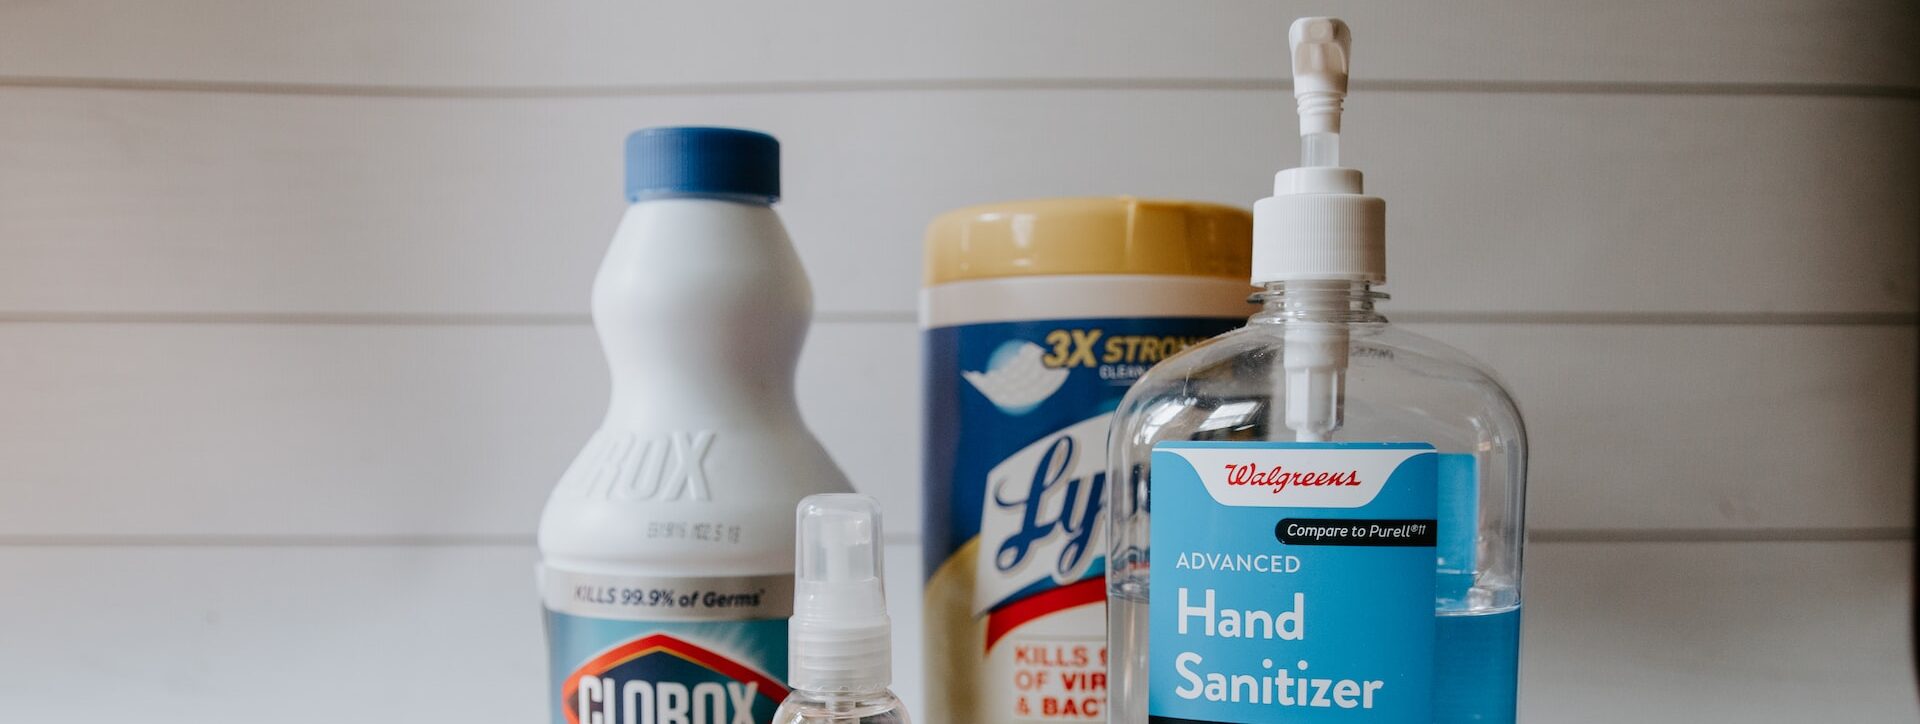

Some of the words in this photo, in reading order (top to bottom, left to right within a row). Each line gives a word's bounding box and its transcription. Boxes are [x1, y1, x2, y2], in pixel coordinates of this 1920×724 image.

[1043, 329, 1102, 368] 3X
[1225, 463, 1361, 494] Walgreens
[994, 436, 1106, 574] Ly
[1287, 523, 1348, 541] Compare
[1351, 525, 1366, 538] to
[1175, 552, 1300, 573] ADVANCED
[575, 585, 616, 604] KILLS
[621, 588, 674, 608] 99.9%
[678, 590, 698, 608] of
[1177, 587, 1304, 640] Hand
[1015, 646, 1088, 667] KILLS
[1014, 670, 1046, 692] OF
[1062, 671, 1107, 692] VIR
[1175, 651, 1384, 709] Sanitizer
[1043, 697, 1107, 717] BAC
